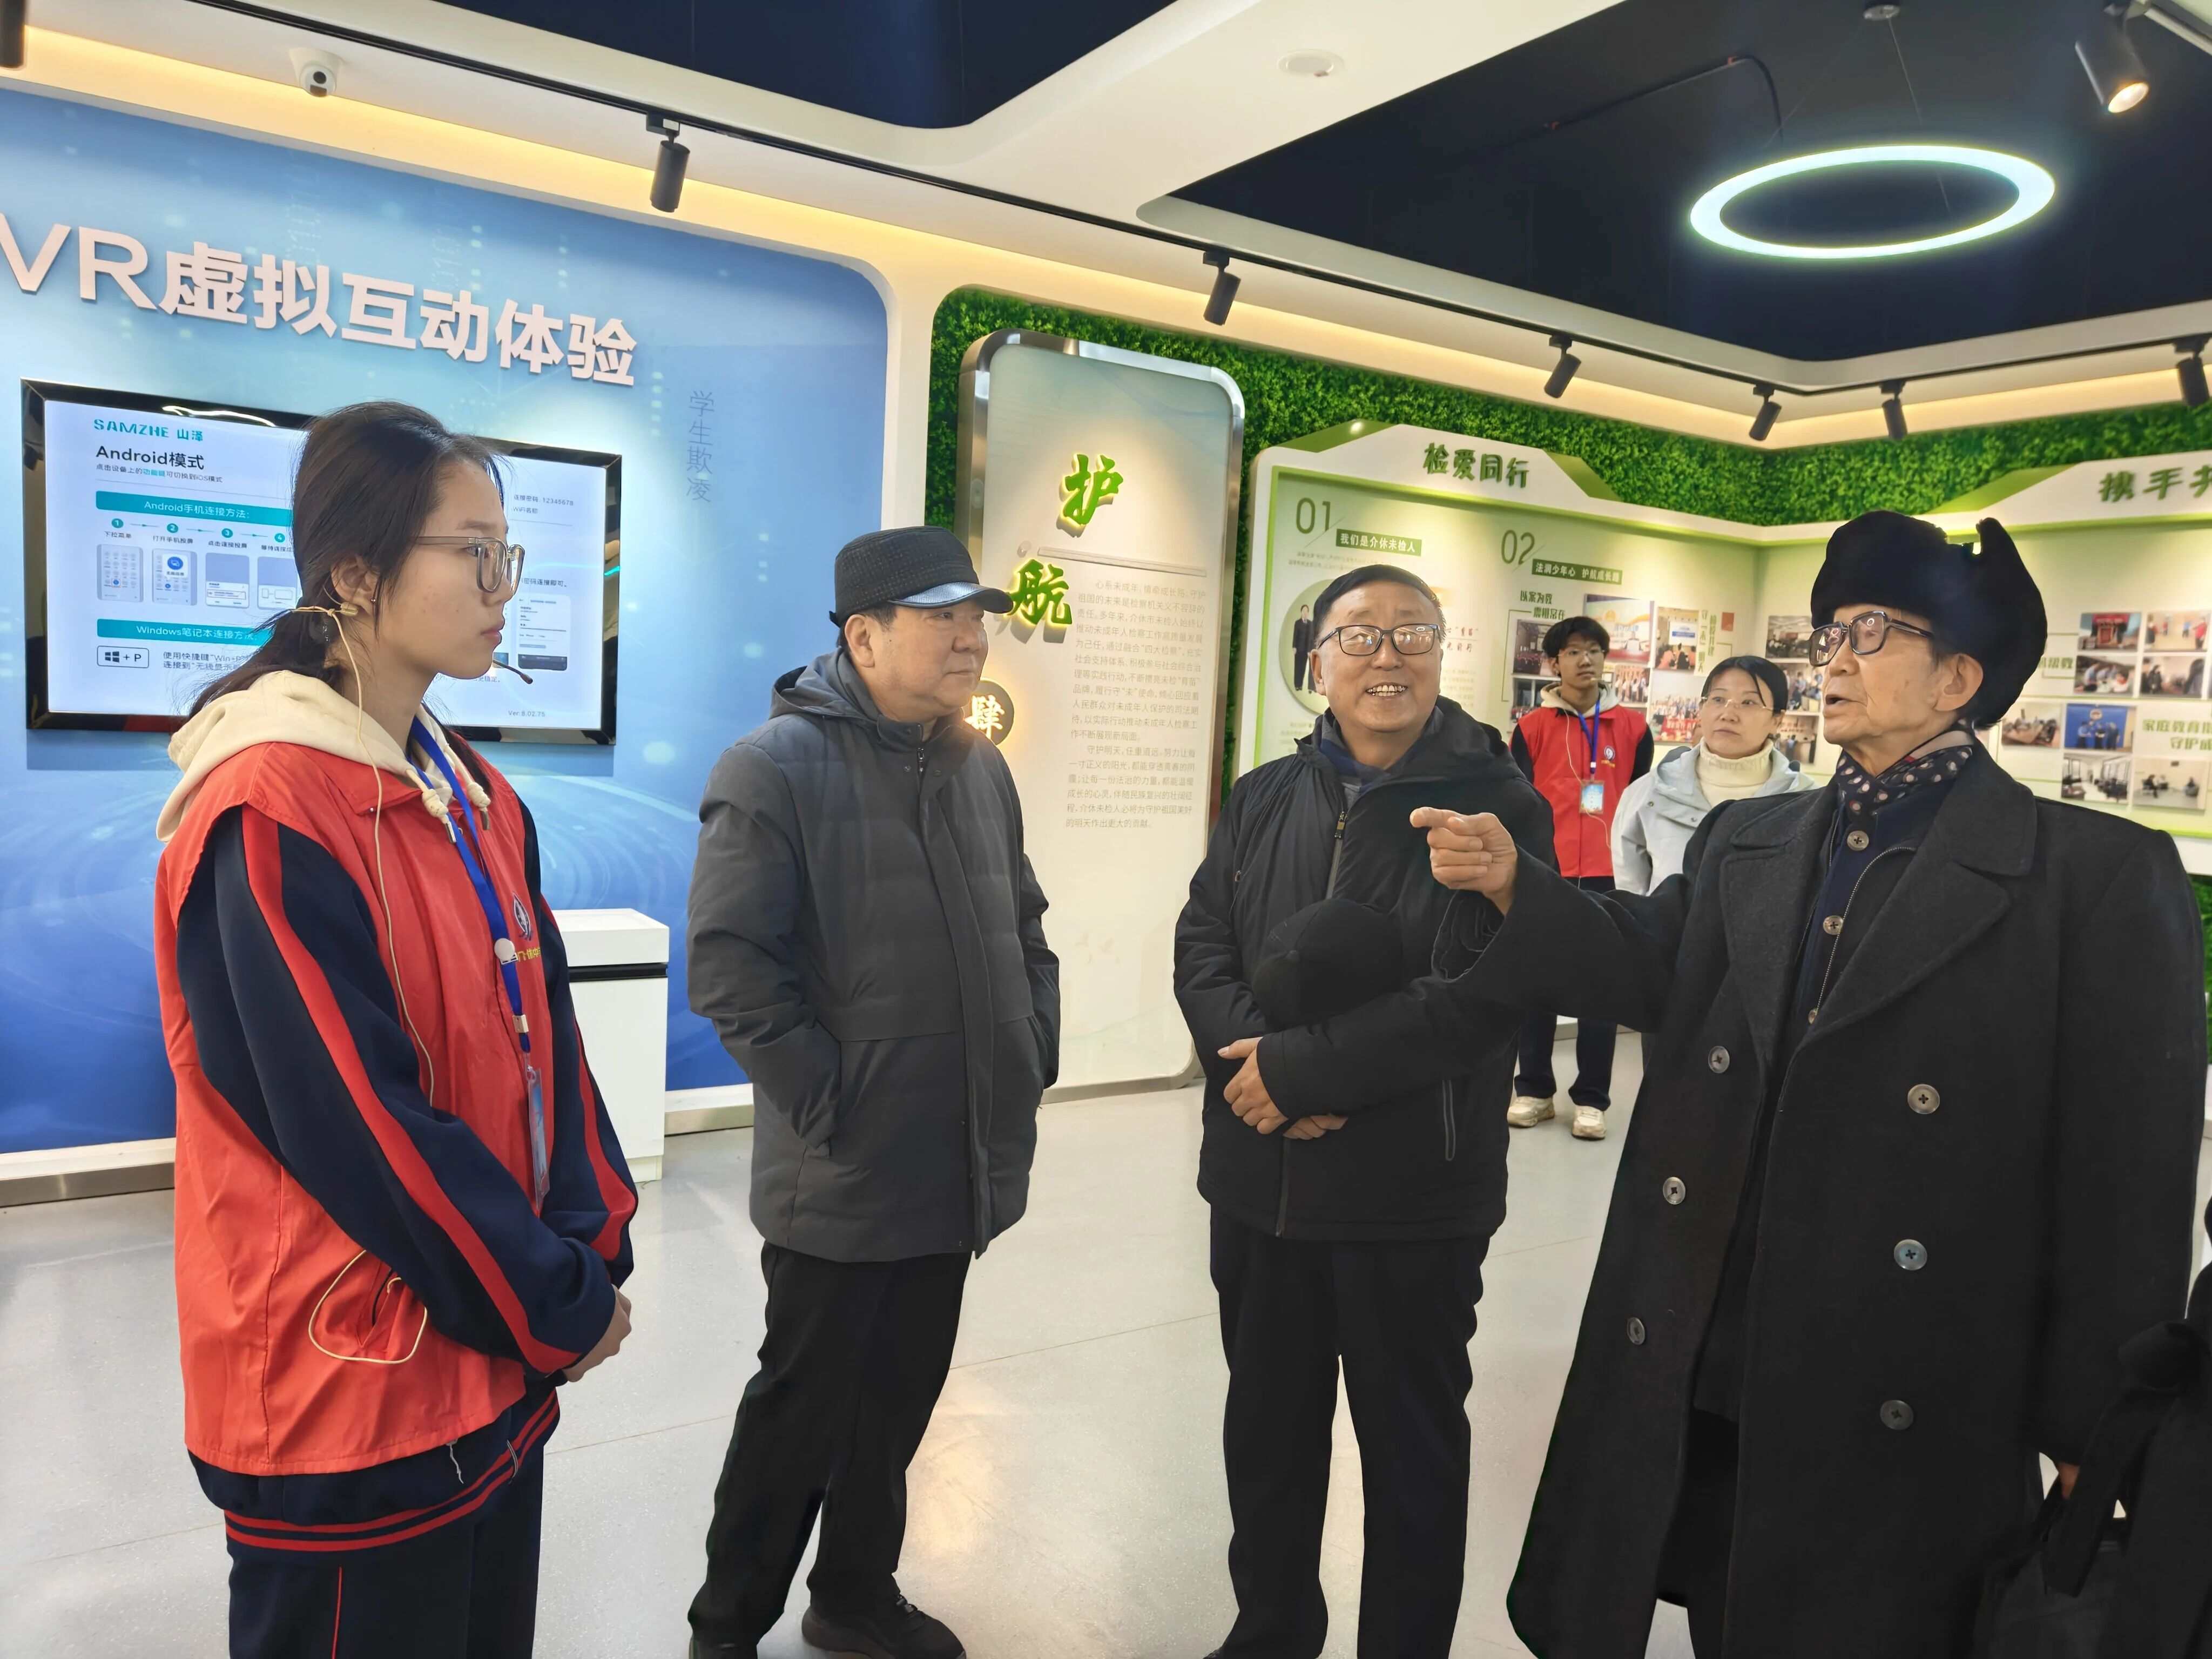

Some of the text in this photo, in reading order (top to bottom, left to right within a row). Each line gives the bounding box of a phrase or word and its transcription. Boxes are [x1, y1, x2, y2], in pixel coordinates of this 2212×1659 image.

[0, 213, 637, 386] VR虚拟互动体验
[93, 419, 204, 442] SAMZHE 山泽
[96, 446, 205, 470] Android模式
[1422, 442, 1530, 488] 检爱同行
[1062, 453, 1124, 526] 护
[1296, 497, 1331, 534] 01
[1340, 532, 1416, 553] 我们是介休未检人
[1501, 530, 1535, 565] 02
[1008, 557, 1073, 625] 航
